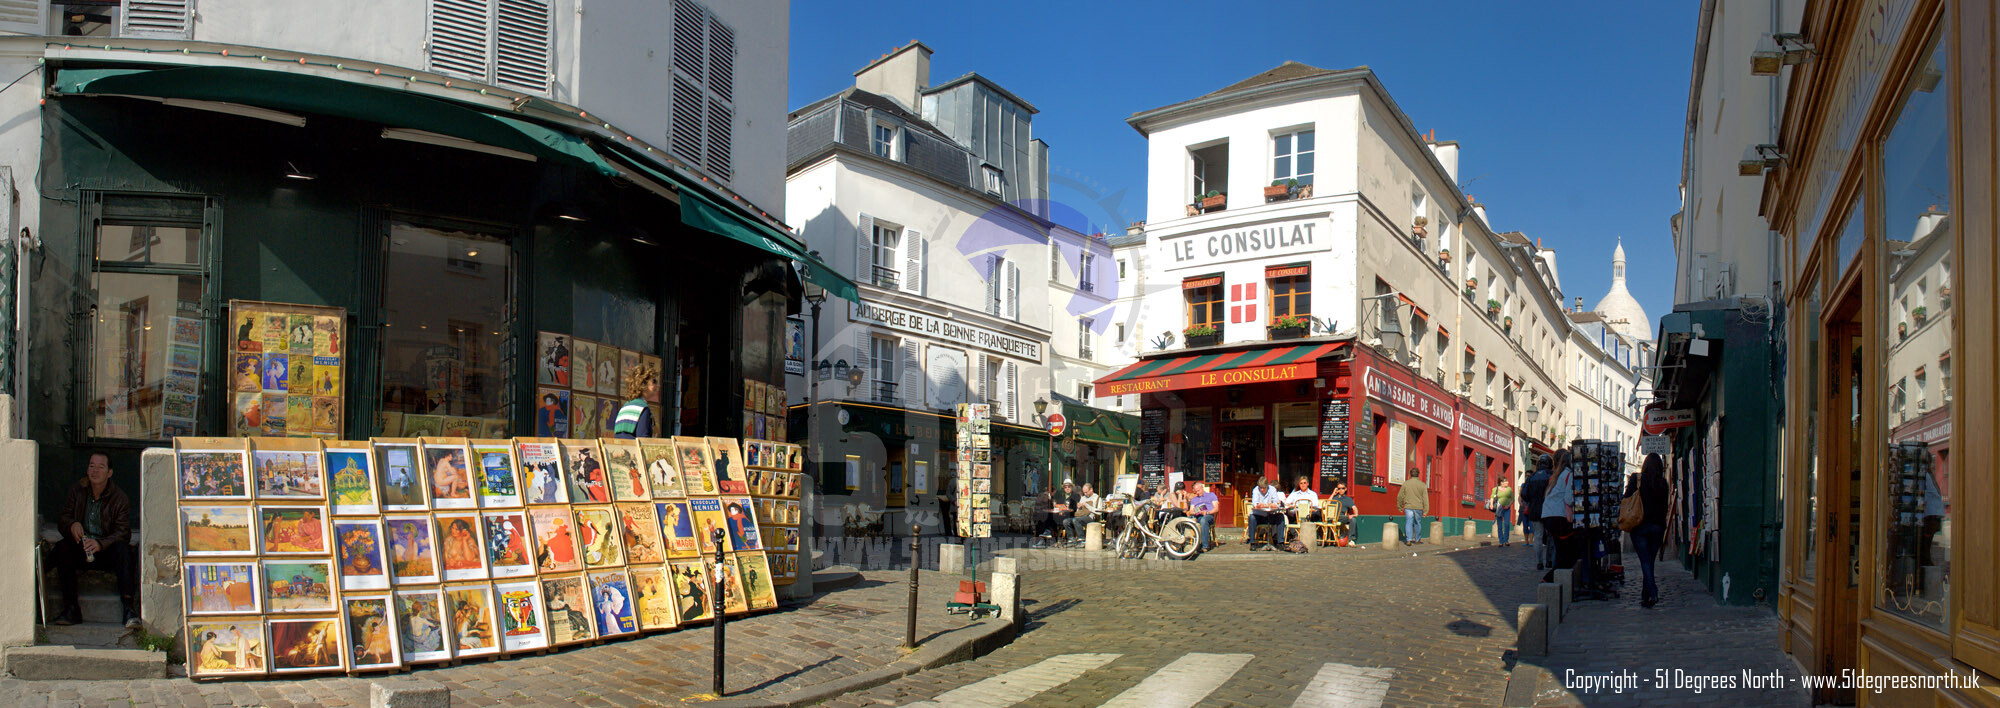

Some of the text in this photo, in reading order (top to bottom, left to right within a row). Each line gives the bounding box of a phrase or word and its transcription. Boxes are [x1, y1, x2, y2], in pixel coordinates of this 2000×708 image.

[1174, 222, 1316, 262] LE CONSULAT
[1277, 267, 1304, 277] CONSULAT
[1185, 278, 1216, 289] RESTAURANT
[856, 303, 1037, 357] AUBERGE DE LA BONNE FRANQUETTE
[1110, 378, 1171, 394] RESTAURANT
[1200, 366, 1297, 386] LE CONSULAT
[1368, 375, 1452, 424] AMBASSADE DE SAVOIE
[1461, 420, 1513, 451] RESTAURANT LE CONSULAT
[676, 539, 695, 547] MAGGI
